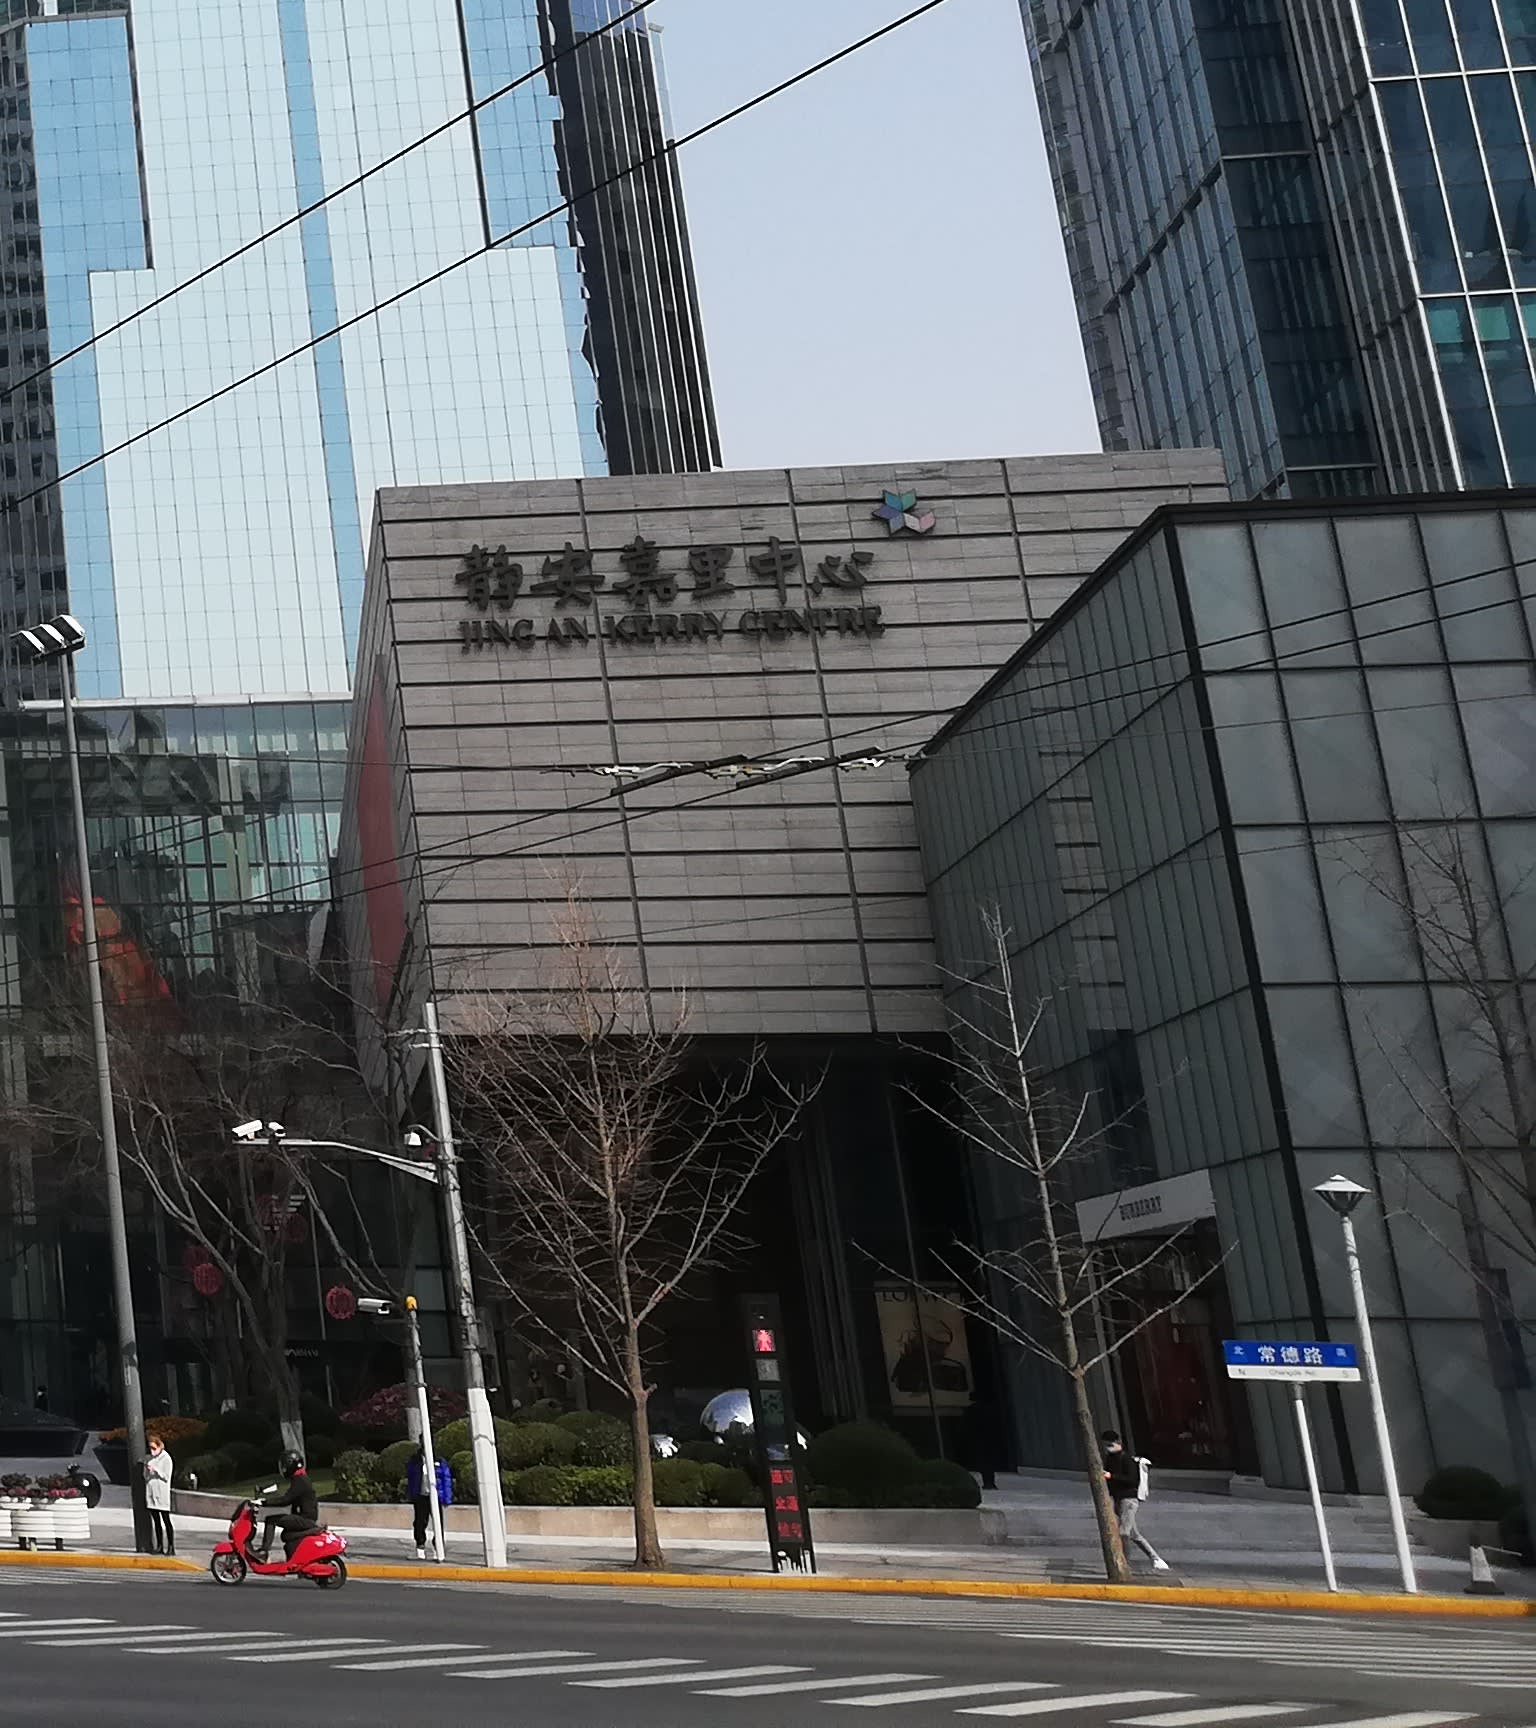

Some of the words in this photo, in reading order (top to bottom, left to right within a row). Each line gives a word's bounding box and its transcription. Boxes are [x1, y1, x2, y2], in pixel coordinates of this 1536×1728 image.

[455, 535, 875, 612] 静安嘉里中心
[458, 618, 537, 656] JING
[546, 616, 591, 648] AN
[603, 610, 729, 648] KERRY
[739, 605, 886, 643] CENTRE
[1118, 1195, 1163, 1221] BURBERRY
[1257, 1344, 1324, 1365] 常德路
